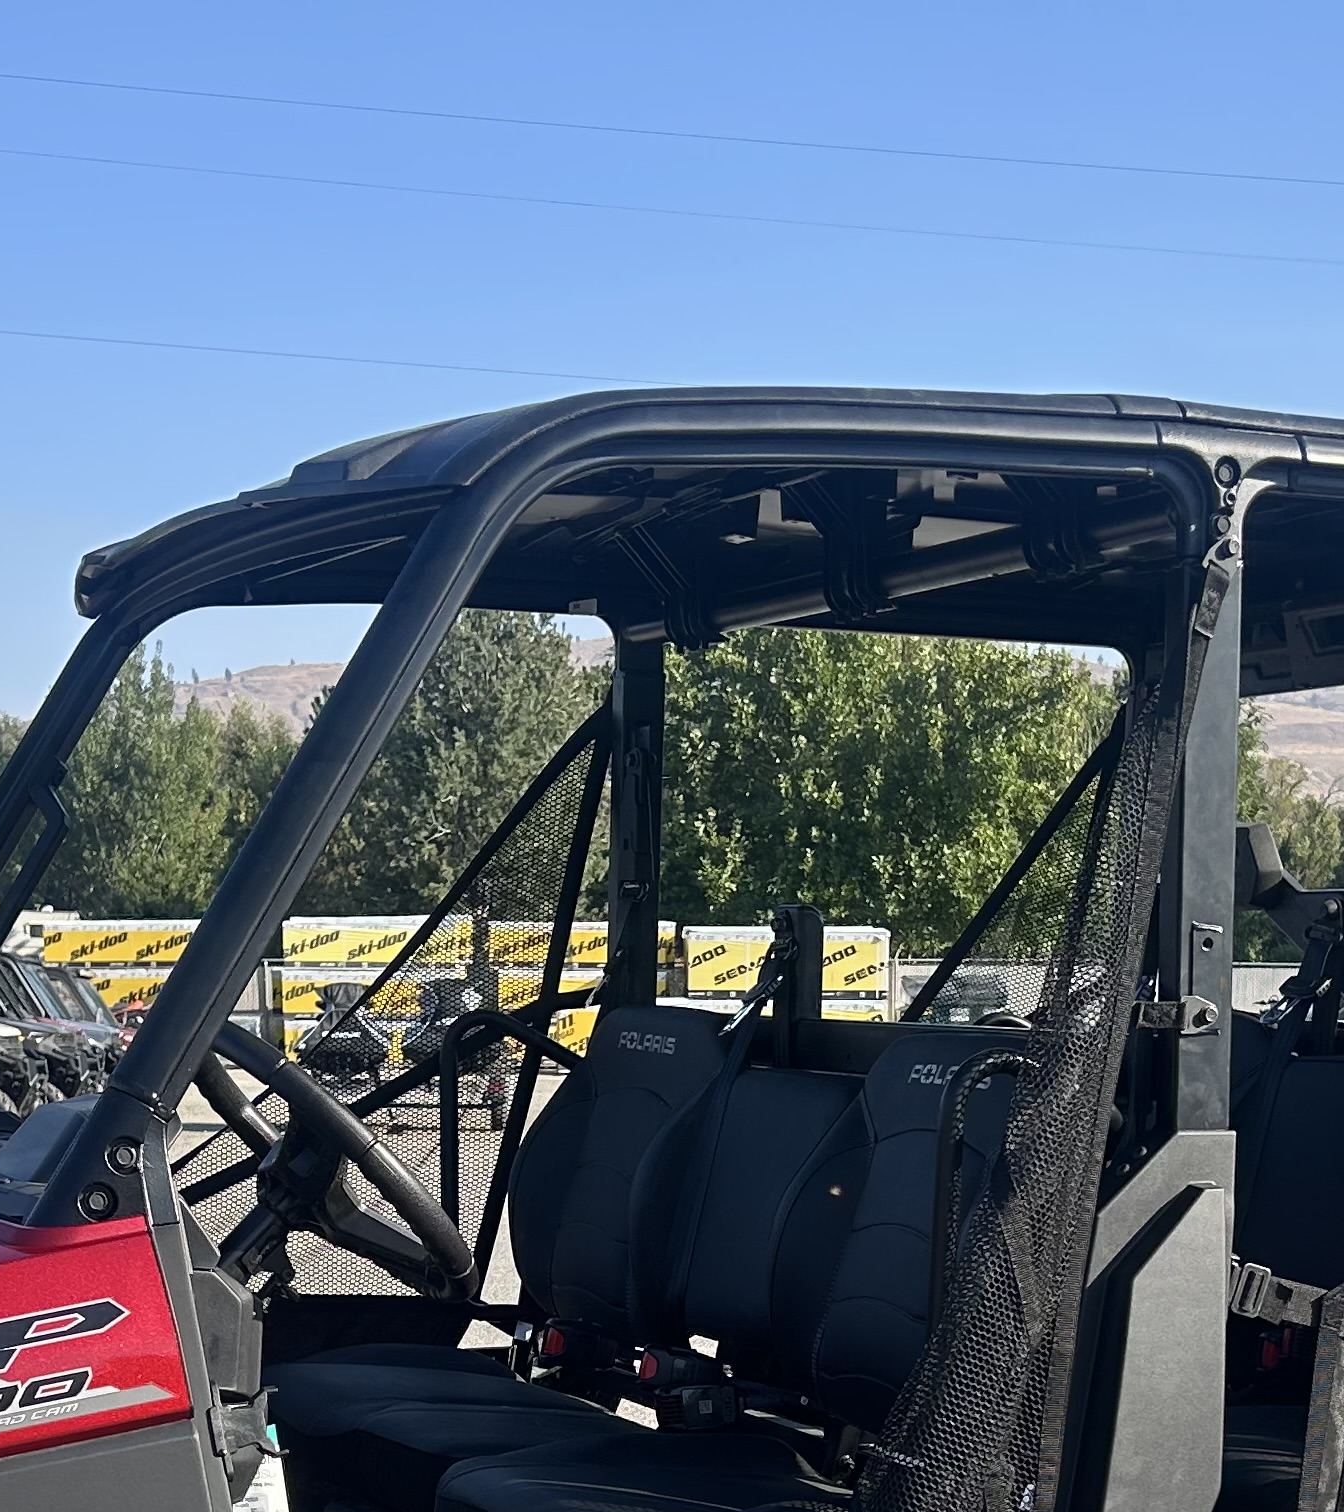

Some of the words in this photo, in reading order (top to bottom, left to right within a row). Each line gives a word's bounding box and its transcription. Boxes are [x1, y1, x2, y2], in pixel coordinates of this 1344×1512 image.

[70, 931, 128, 961] ski-doo
[347, 930, 407, 961] ski-doo
[618, 1031, 677, 1056] POLARIS
[30, 1402, 79, 1421] CAM
